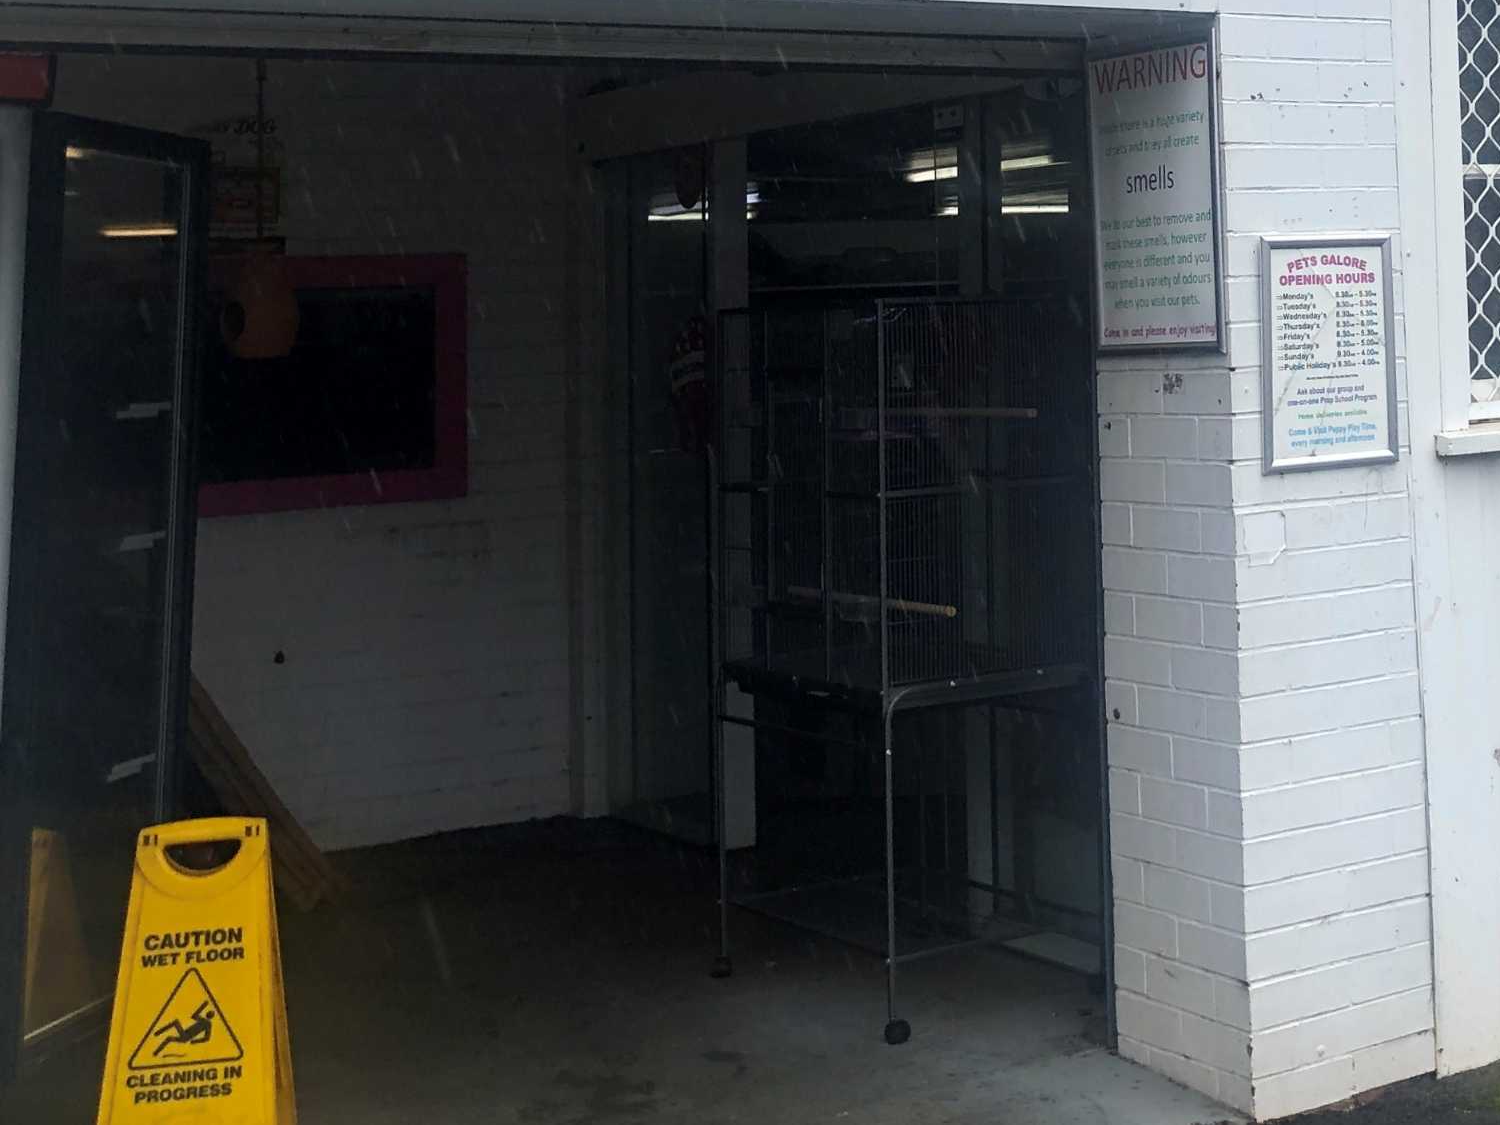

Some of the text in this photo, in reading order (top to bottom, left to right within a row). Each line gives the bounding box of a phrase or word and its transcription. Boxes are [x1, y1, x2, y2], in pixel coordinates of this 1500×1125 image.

[1094, 45, 1206, 94] WARNING
[1176, 111, 1204, 124] variety
[1174, 135, 1200, 147] create
[1126, 165, 1175, 194] smells
[1153, 214, 1161, 227] to
[1195, 209, 1211, 221] and
[1171, 231, 1207, 244] however
[1177, 252, 1192, 264] and
[1194, 253, 1210, 266] you
[1287, 254, 1367, 273] PETS GALORE
[1182, 273, 1211, 285] odours
[1279, 273, 1375, 286] OPENING HOURS
[1283, 293, 1314, 301] Monday's
[1283, 303, 1316, 311] Tuesday's
[1283, 312, 1327, 320] Wednesday's
[143, 927, 244, 951] CAUTION
[141, 947, 244, 968] WET FLOOR
[126, 1065, 242, 1088] CLEANING IN
[134, 1082, 233, 1104] PROGRESS
